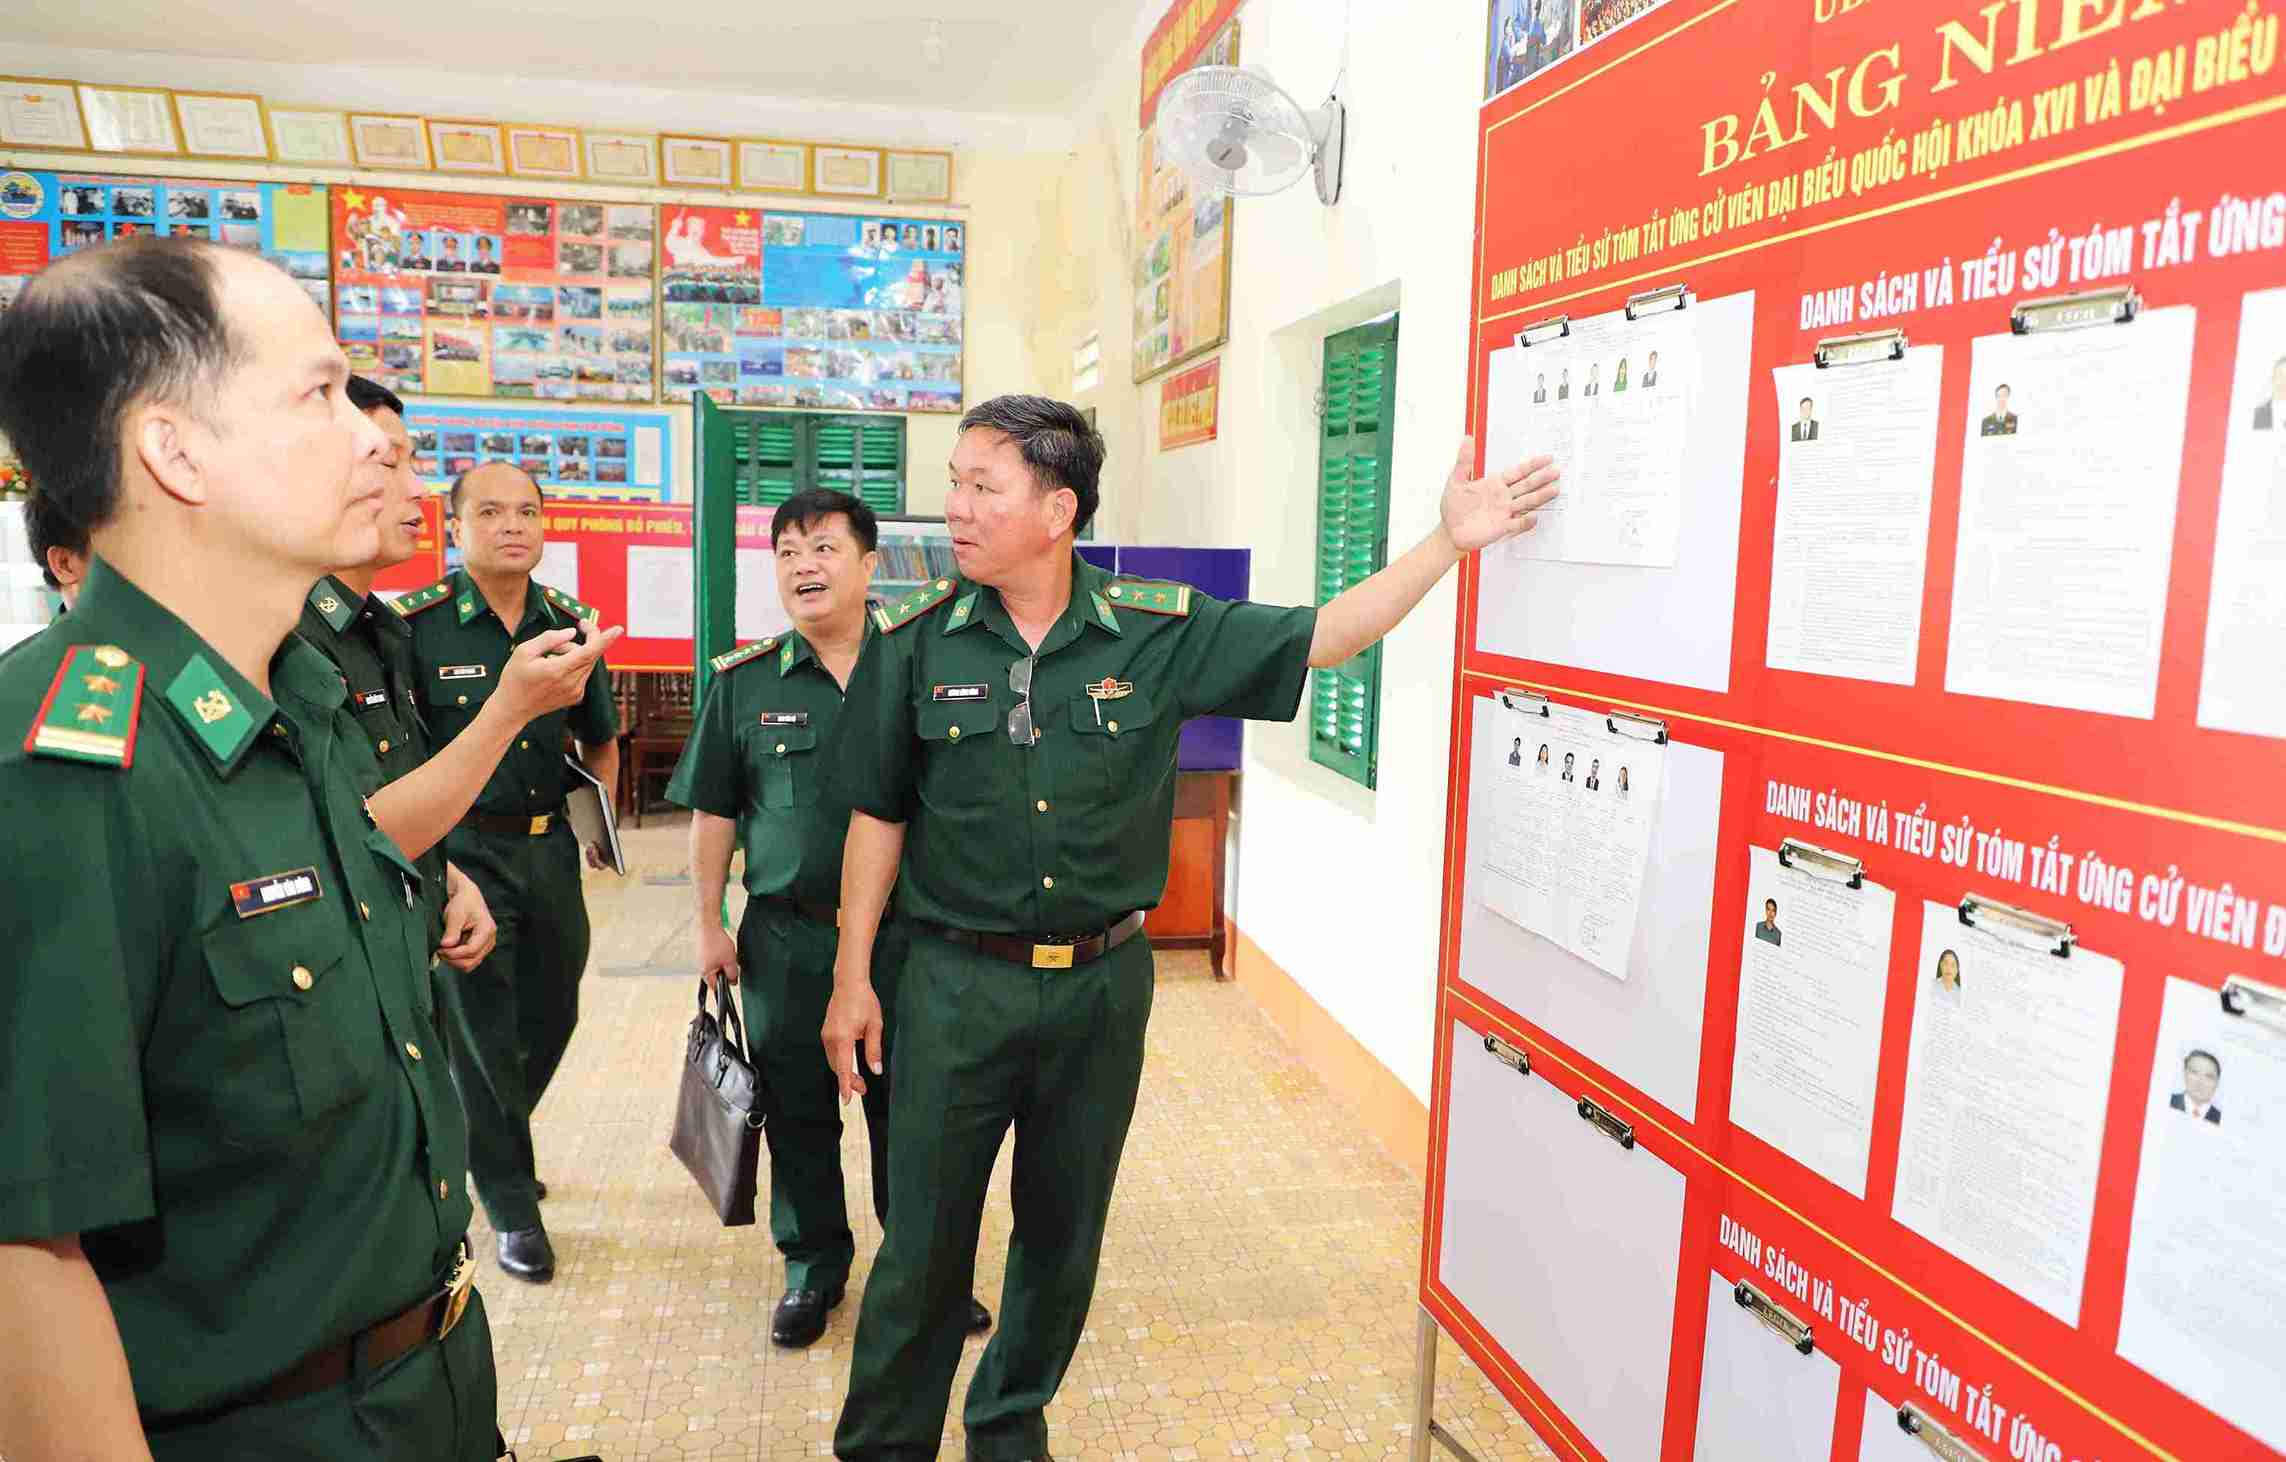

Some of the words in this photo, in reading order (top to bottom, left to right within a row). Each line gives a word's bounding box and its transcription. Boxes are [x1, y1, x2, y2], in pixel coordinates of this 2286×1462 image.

[1491, 266, 1518, 301] DANH
[1519, 254, 1547, 292] SÁCH
[1548, 246, 1563, 284] VÀ
[1565, 231, 1591, 279] TIỂU
[1593, 226, 1611, 270] SỬ
[1612, 225, 1640, 265] TÓM
[1643, 207, 1667, 256] TẮT
[1669, 206, 1699, 248] ỨNG
[1702, 186, 1725, 238] CỬ
[1727, 182, 1765, 230] VIÊN
[1768, 174, 1798, 222] ĐẠI
[1802, 145, 1846, 208] BIỂU
[1851, 127, 1907, 197] QUỐC
[1911, 118, 1952, 180] HỘI
[1956, 95, 2024, 163] KHÓA
[2029, 81, 2077, 142] XVI
[2084, 57, 2121, 125] VÀ
[2129, 44, 2187, 117] ĐẠI
[2192, 0, 2279, 93] BIỂU
[1697, 42, 1908, 177] BẢNG
[1800, 285, 1854, 330] DANH
[1859, 270, 1918, 322] SÁCH
[1923, 256, 1954, 310] VÀ
[1961, 236, 2018, 302] TIỂU
[2022, 227, 2066, 292] SỬ
[2068, 223, 2133, 283] TÓM
[2141, 196, 2201, 271] TẮT
[2208, 192, 2286, 258] ỨNG
[1766, 779, 1812, 824] DANH
[1815, 788, 1861, 838] SÁCH
[1865, 799, 1888, 845] VÀ
[1894, 801, 1935, 860] TIỂU
[1940, 814, 1973, 868] SỬ
[1976, 827, 2024, 884] TÓM
[2030, 834, 2075, 896] TẮT
[2078, 849, 2133, 914] ỨNG
[2139, 864, 2184, 928] CỬ
[2186, 882, 2259, 950] VIÊN
[2263, 904, 2286, 959] Đ
[1719, 1213, 1762, 1270] DANH
[1765, 1246, 1809, 1303] SÁCH
[1813, 1277, 1834, 1322] VÀ
[1839, 1298, 1879, 1353] TIỂU
[1881, 1328, 1911, 1376] SỬ
[1915, 1348, 1960, 1413] TÓM
[1965, 1383, 2006, 1444] TẮT
